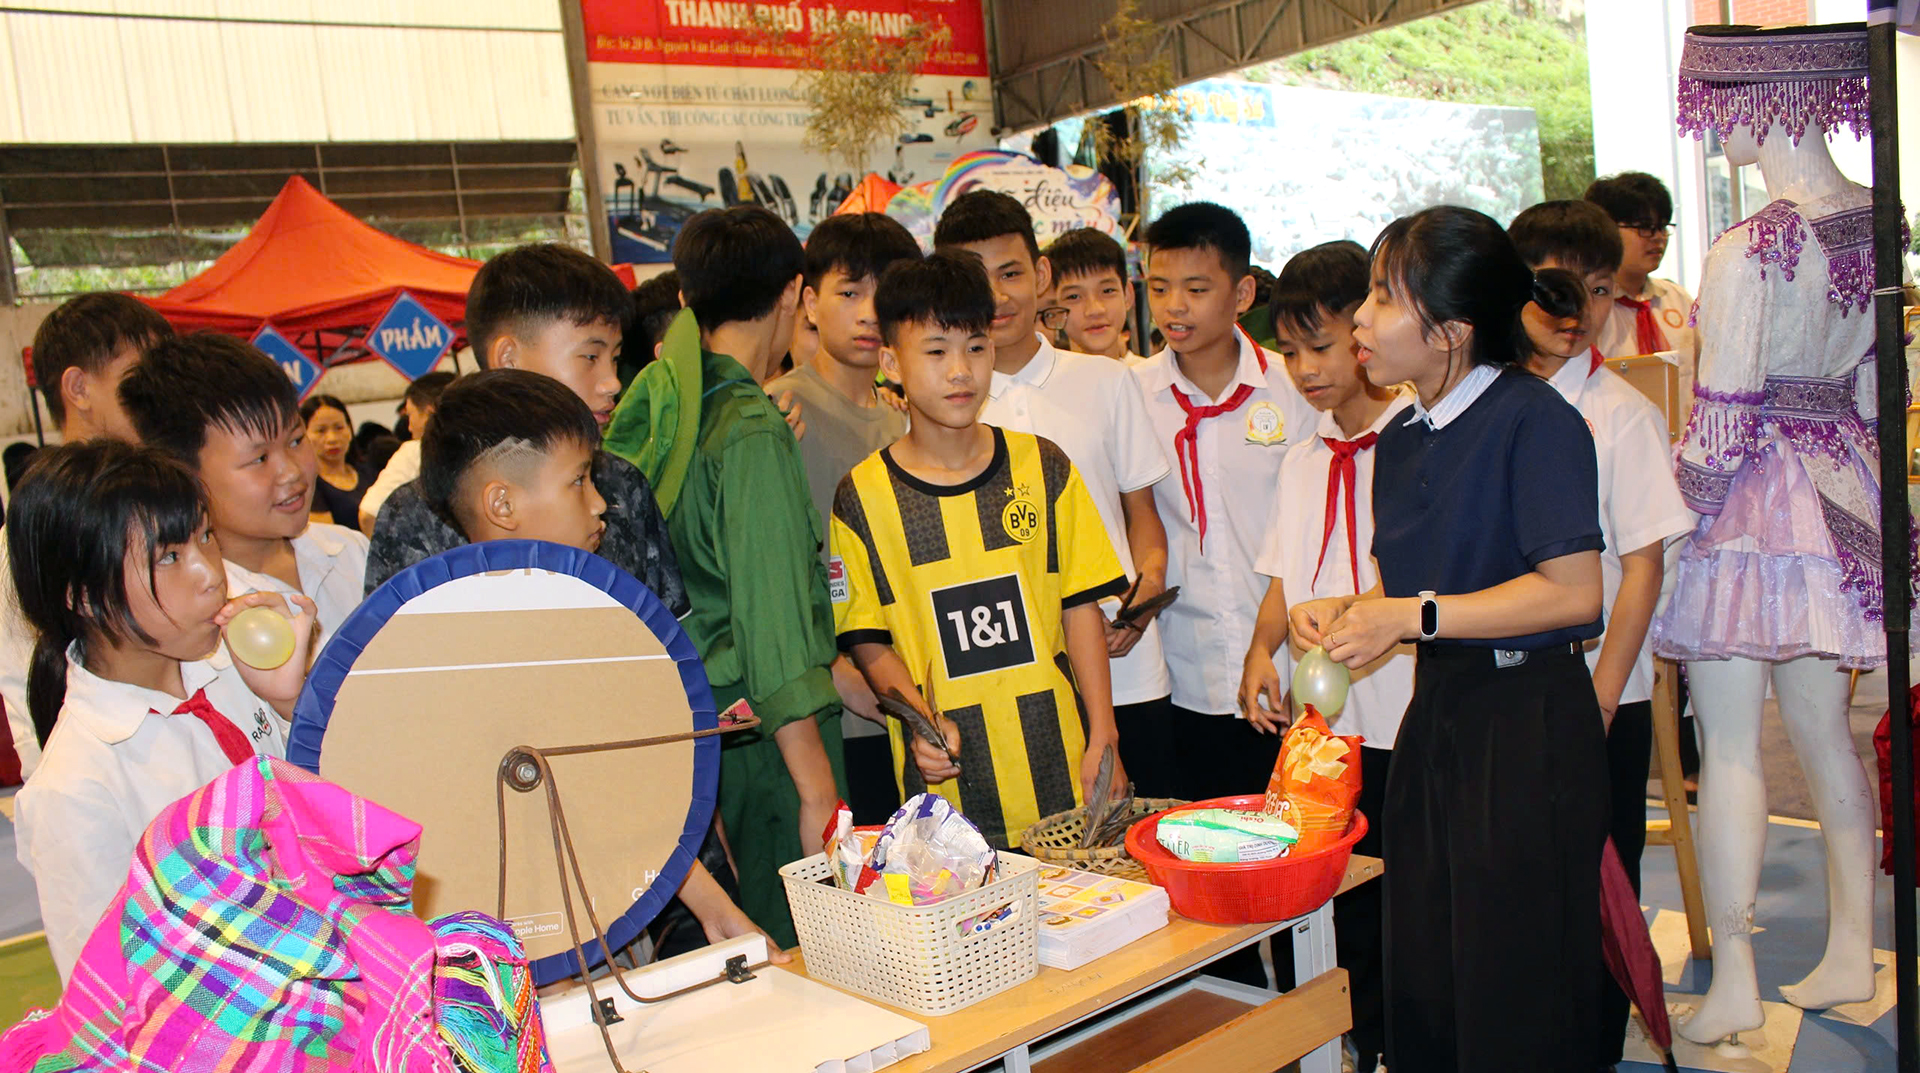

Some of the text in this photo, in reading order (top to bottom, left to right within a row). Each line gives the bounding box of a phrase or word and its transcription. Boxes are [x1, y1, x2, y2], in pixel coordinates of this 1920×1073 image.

[1010, 504, 1037, 529] BVB
[1020, 528, 1030, 537] 09
[831, 588, 845, 598] GA
[947, 600, 1020, 651] 1&1
[514, 922, 559, 936] pple Home
